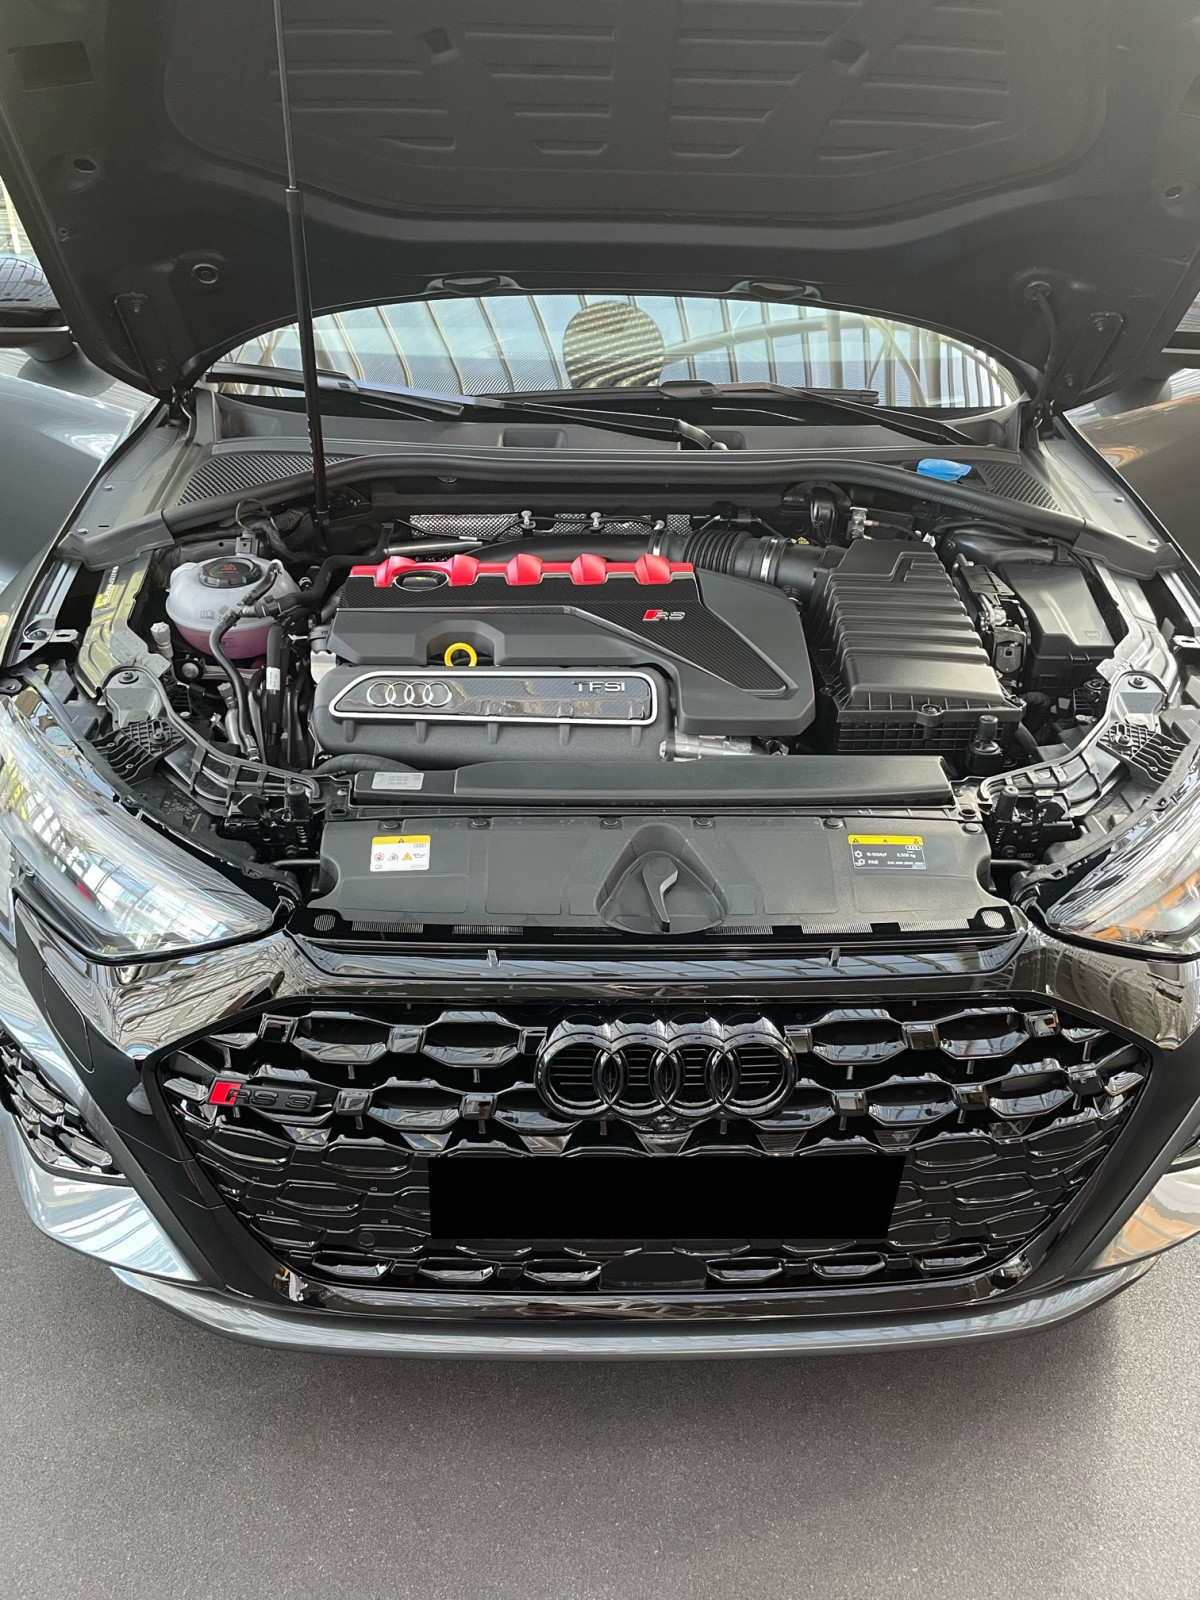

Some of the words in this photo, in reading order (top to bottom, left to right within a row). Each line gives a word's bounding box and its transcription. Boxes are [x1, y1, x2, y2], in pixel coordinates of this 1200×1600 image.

[645, 609, 686, 621] RS
[572, 681, 626, 692] TFSI
[214, 1083, 278, 1106] RS
[285, 1093, 311, 1109] 3
